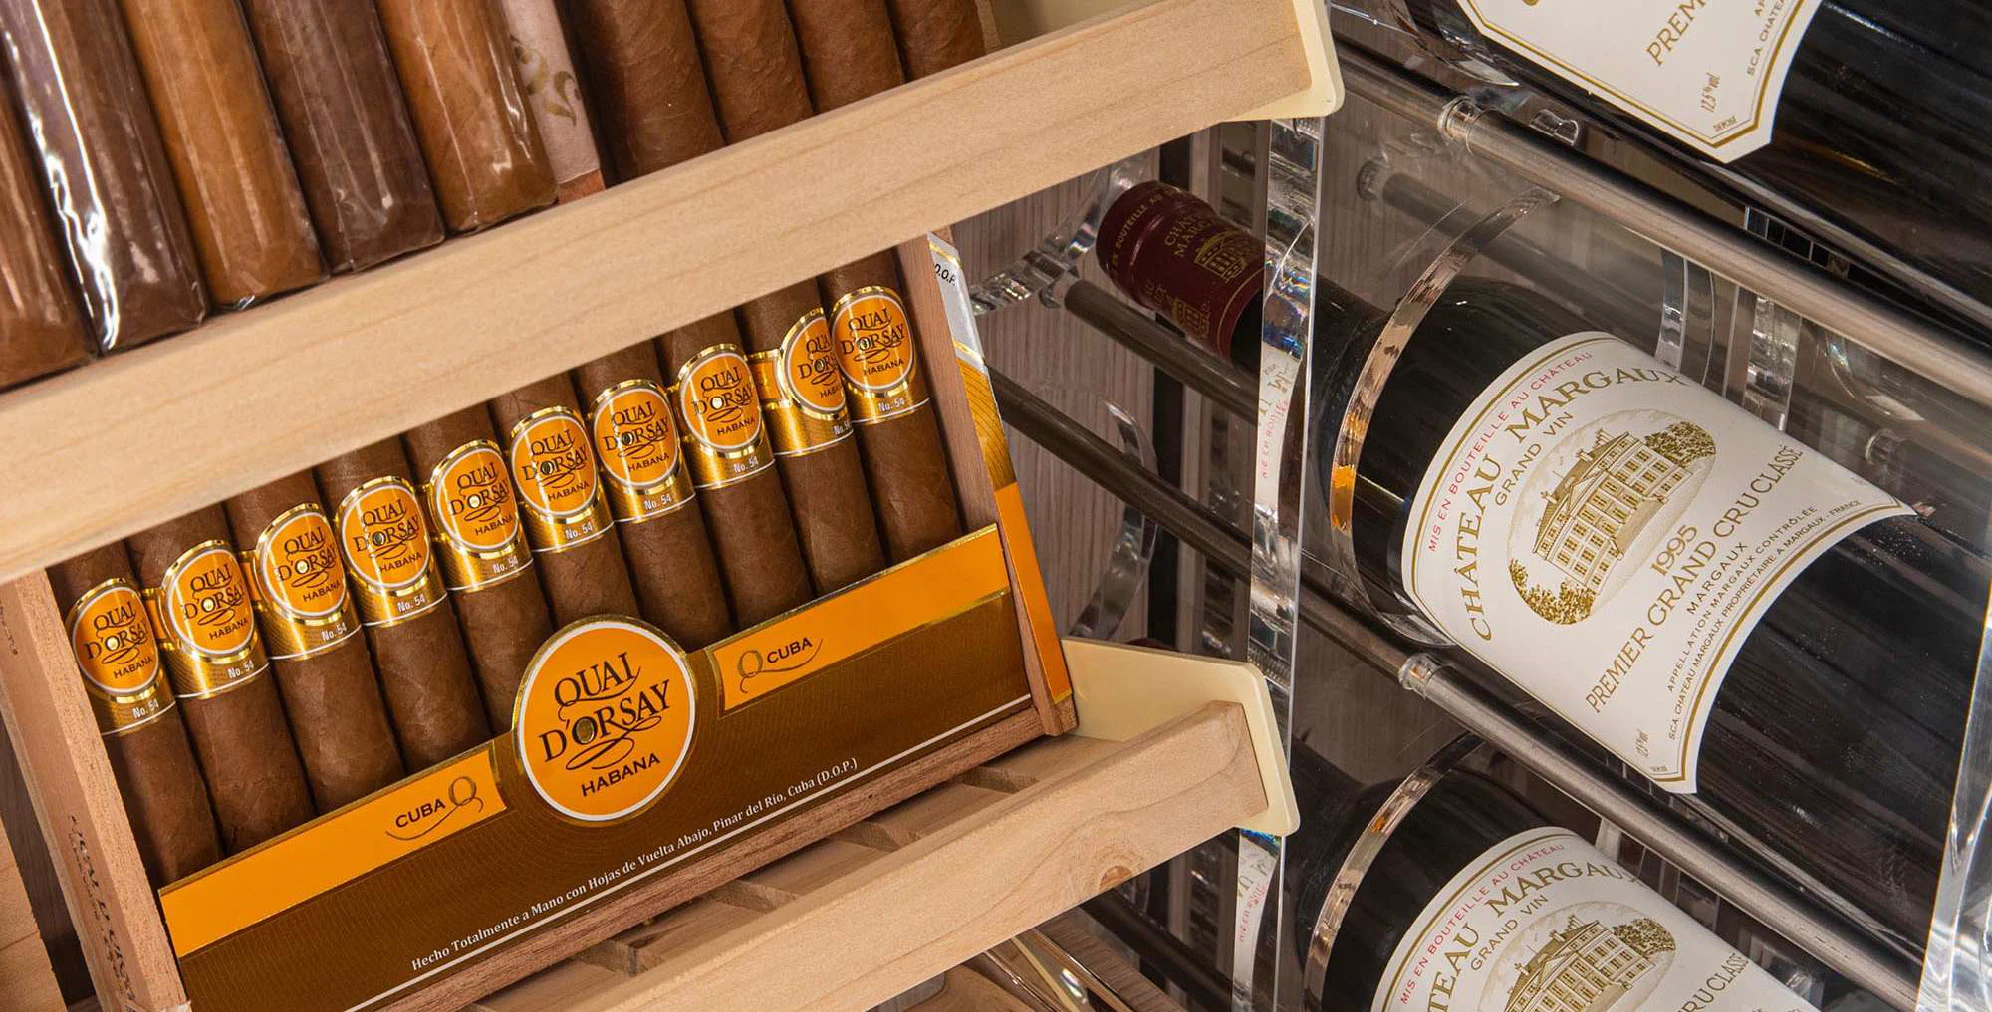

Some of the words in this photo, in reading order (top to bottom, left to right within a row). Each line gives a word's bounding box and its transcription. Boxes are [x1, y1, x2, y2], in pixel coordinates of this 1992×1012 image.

[848, 308, 892, 332] QUAI
[701, 366, 742, 391] QUAI
[612, 401, 656, 426] QUAI
[1504, 366, 1690, 444] MARGAUX
[531, 429, 576, 457] QUAI
[1495, 443, 1542, 506] GRAND
[1543, 411, 1574, 438] VIN
[457, 462, 498, 490] QUAI
[1428, 524, 1441, 553] MIS
[1437, 499, 1451, 521] EN
[1449, 410, 1510, 495] BOUTEILLE
[1509, 391, 1530, 410] AU
[362, 498, 406, 527] QUAI
[284, 526, 325, 555] QUAI
[1651, 524, 1698, 576] 1995
[190, 564, 232, 593] QUAI
[1585, 626, 1654, 713] PREMIER
[1647, 540, 1717, 626] GRAND
[1713, 492, 1760, 538] CRU
[1686, 541, 1748, 615] MARGAUX
[1692, 619, 1724, 668] MARGAUX
[1783, 515, 1825, 549] MARGAUX
[94, 601, 136, 632] QUAI
[1666, 611, 1712, 694] APPELLATION
[1710, 555, 1756, 609] MARGAUX
[766, 637, 813, 664] CUBA
[554, 652, 641, 708] QUAI
[538, 679, 671, 763] D'ORSAY
[581, 752, 661, 797] HABANA
[395, 798, 446, 828] CUBA
[411, 946, 450, 971] Hecho
[451, 914, 520, 952] Totalmente
[522, 911, 531, 921] a
[530, 895, 564, 917] Mano
[566, 885, 587, 900] con
[588, 869, 622, 890] Hojas
[622, 861, 637, 875] de
[637, 843, 675, 867] Vuelta
[676, 828, 713, 849] Abajo,
[712, 811, 744, 832] Pinar
[745, 800, 764, 817] del
[787, 778, 815, 798] Cuba
[816, 757, 859, 786] (D.O.P.)
[1400, 979, 1416, 1004] MIS
[1413, 957, 1429, 977] EN
[1427, 886, 1490, 955] BOUTEILLE
[1491, 872, 1509, 887] AU
[1470, 919, 1519, 971] GRAND
[1520, 894, 1549, 916] VIN
